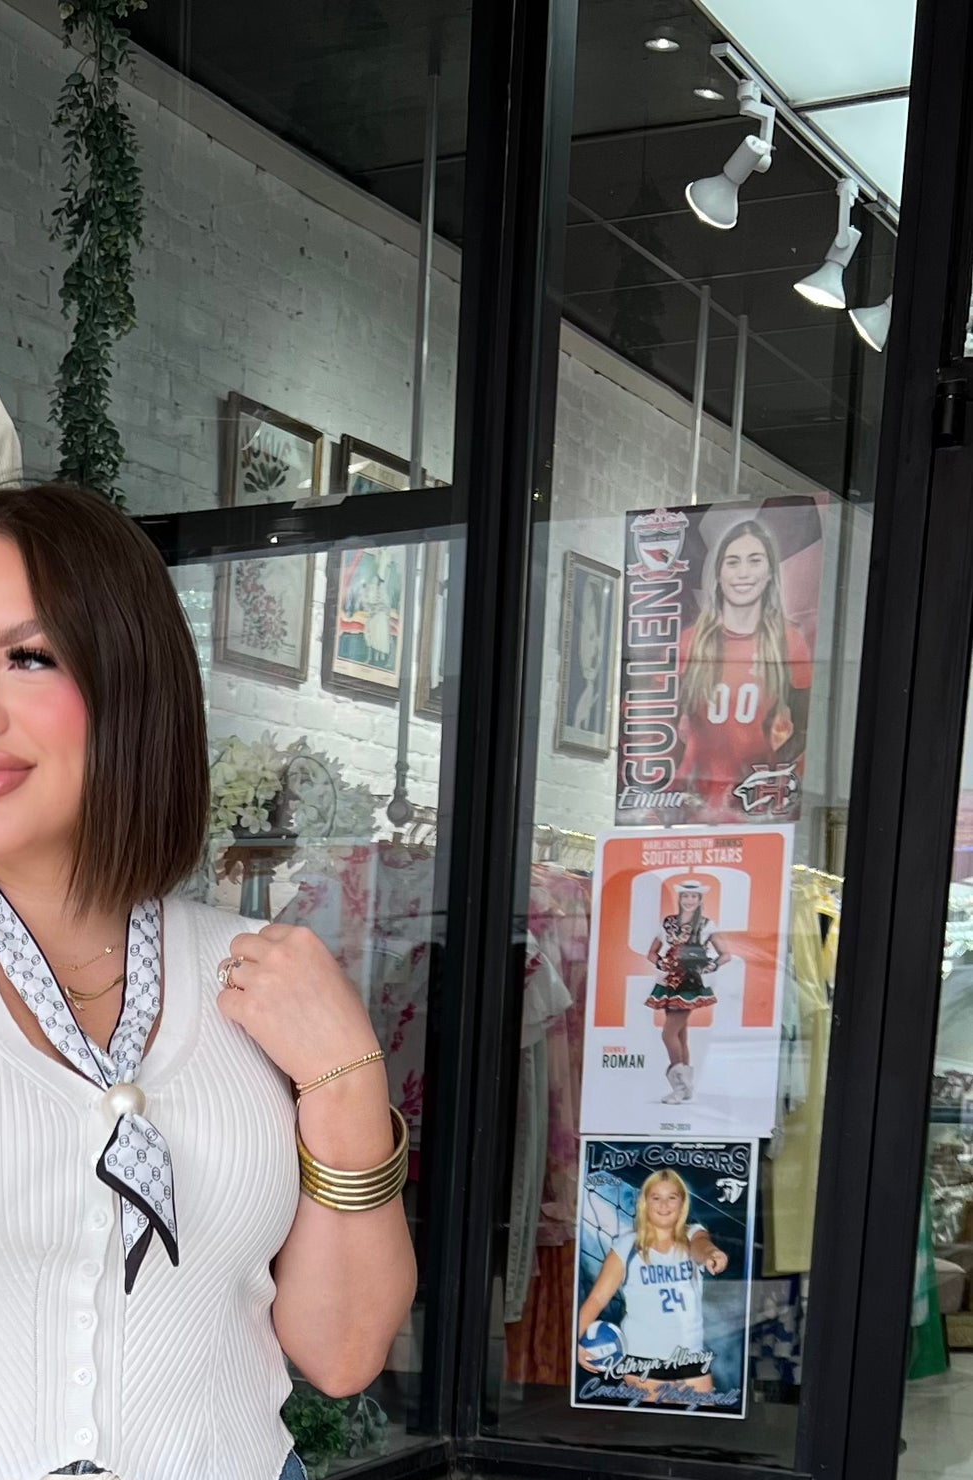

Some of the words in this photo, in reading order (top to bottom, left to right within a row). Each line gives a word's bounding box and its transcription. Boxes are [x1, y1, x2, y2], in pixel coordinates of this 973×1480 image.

[624, 579, 682, 793] GUILLEN
[707, 683, 759, 724] 00
[642, 850, 703, 866] SOUTHERN
[705, 848, 743, 863] STARS
[602, 1054, 645, 1068] ROMAN
[588, 1144, 639, 1171] LADY
[643, 1143, 750, 1179] COUGARS
[639, 1260, 694, 1285] CORKLEY
[659, 1289, 687, 1313] 24
[603, 1355, 661, 1382] Kathryn
[664, 1345, 714, 1374] Albury
